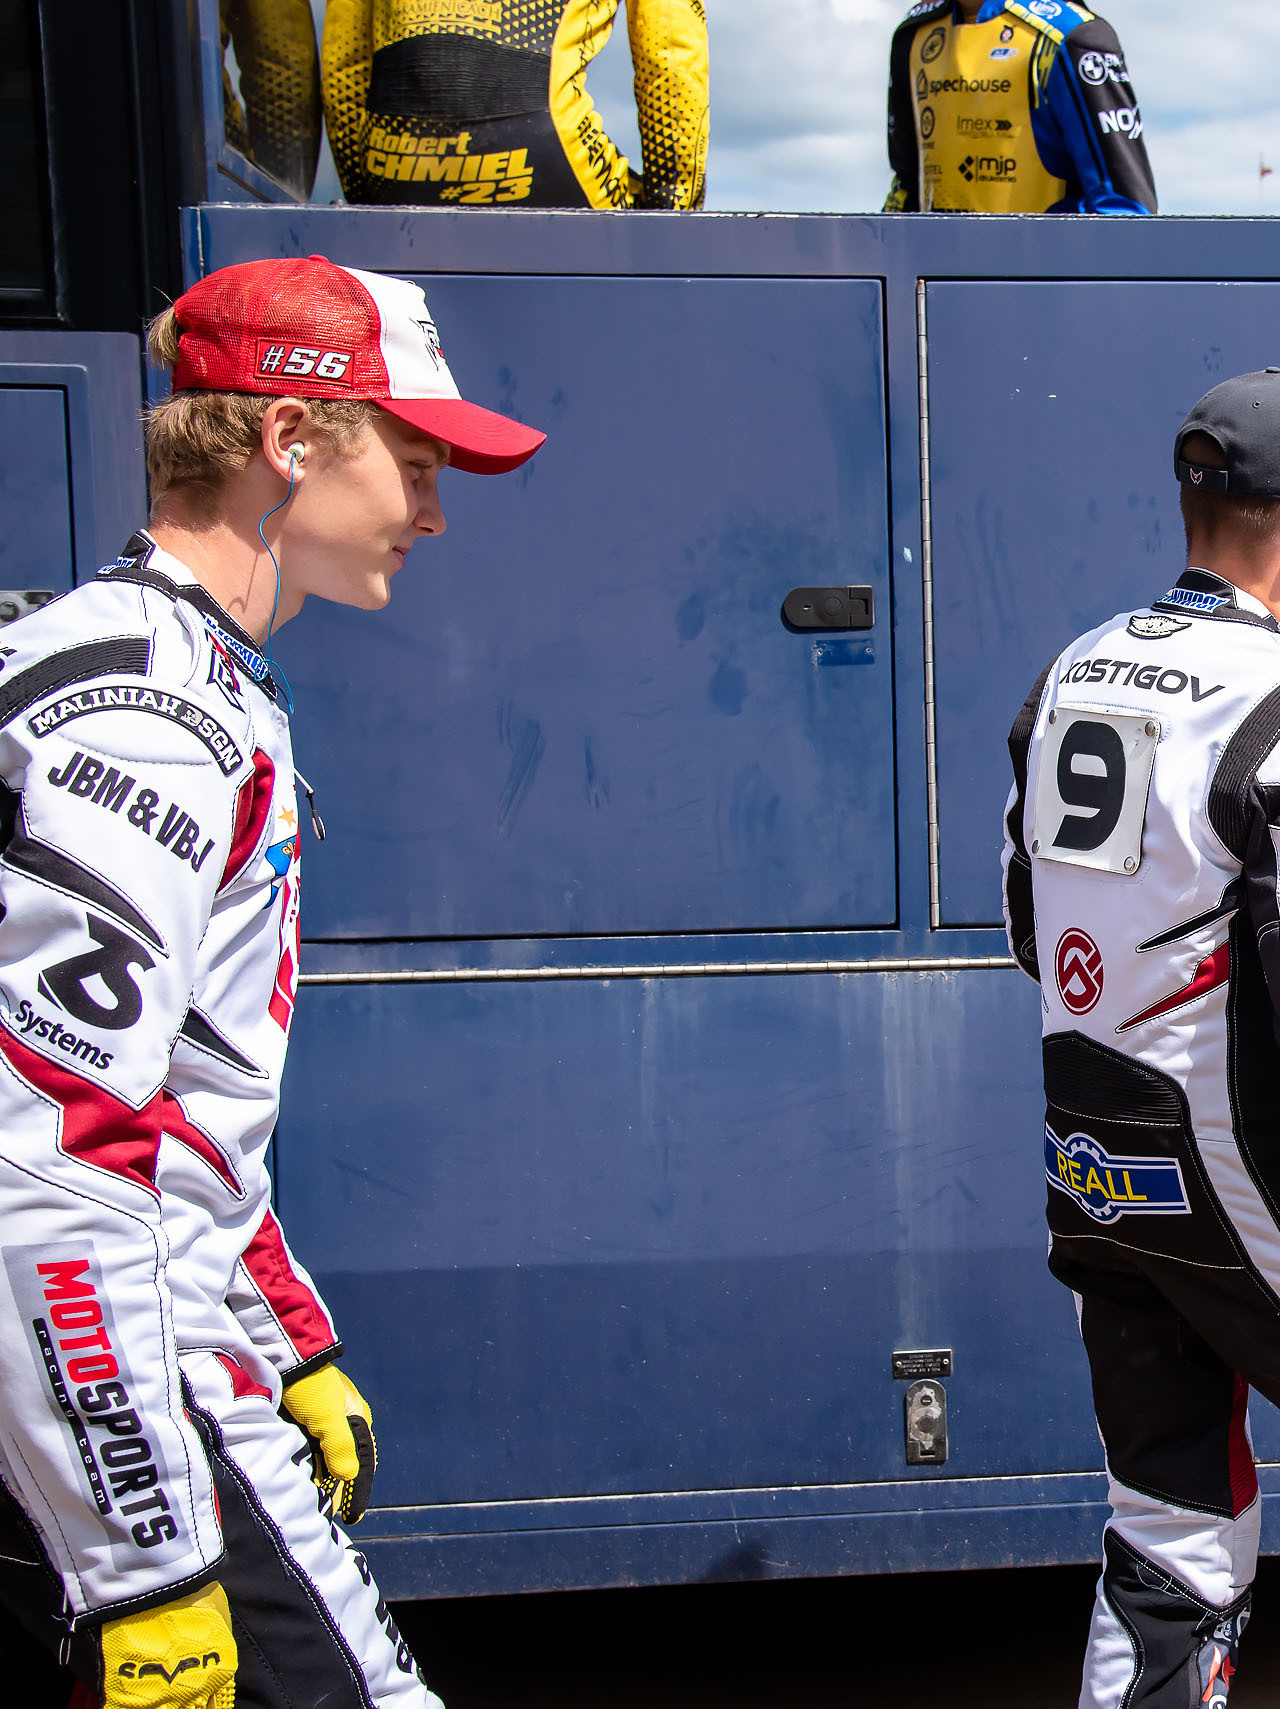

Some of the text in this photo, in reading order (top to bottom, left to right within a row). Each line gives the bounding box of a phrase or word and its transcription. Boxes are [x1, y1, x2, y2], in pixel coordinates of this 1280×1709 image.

[930, 75, 1011, 97] spechouse
[367, 126, 472, 155] Robert
[366, 148, 535, 183] CHMIEL
[979, 155, 1017, 175] mjp
[439, 176, 534, 204] #23
[260, 344, 352, 380] #56
[1059, 658, 1226, 702] KOSTIGOV
[31, 686, 182, 734] MALINIAK
[1051, 720, 1127, 851] 9
[47, 751, 216, 873] JBM & VBJ
[15, 999, 114, 1070] Systems
[1056, 1148, 1148, 1201] REALL
[36, 1258, 179, 1550] MOTOSPORTS
[37, 1328, 108, 1507] racing team
[118, 1651, 221, 1685] seven
